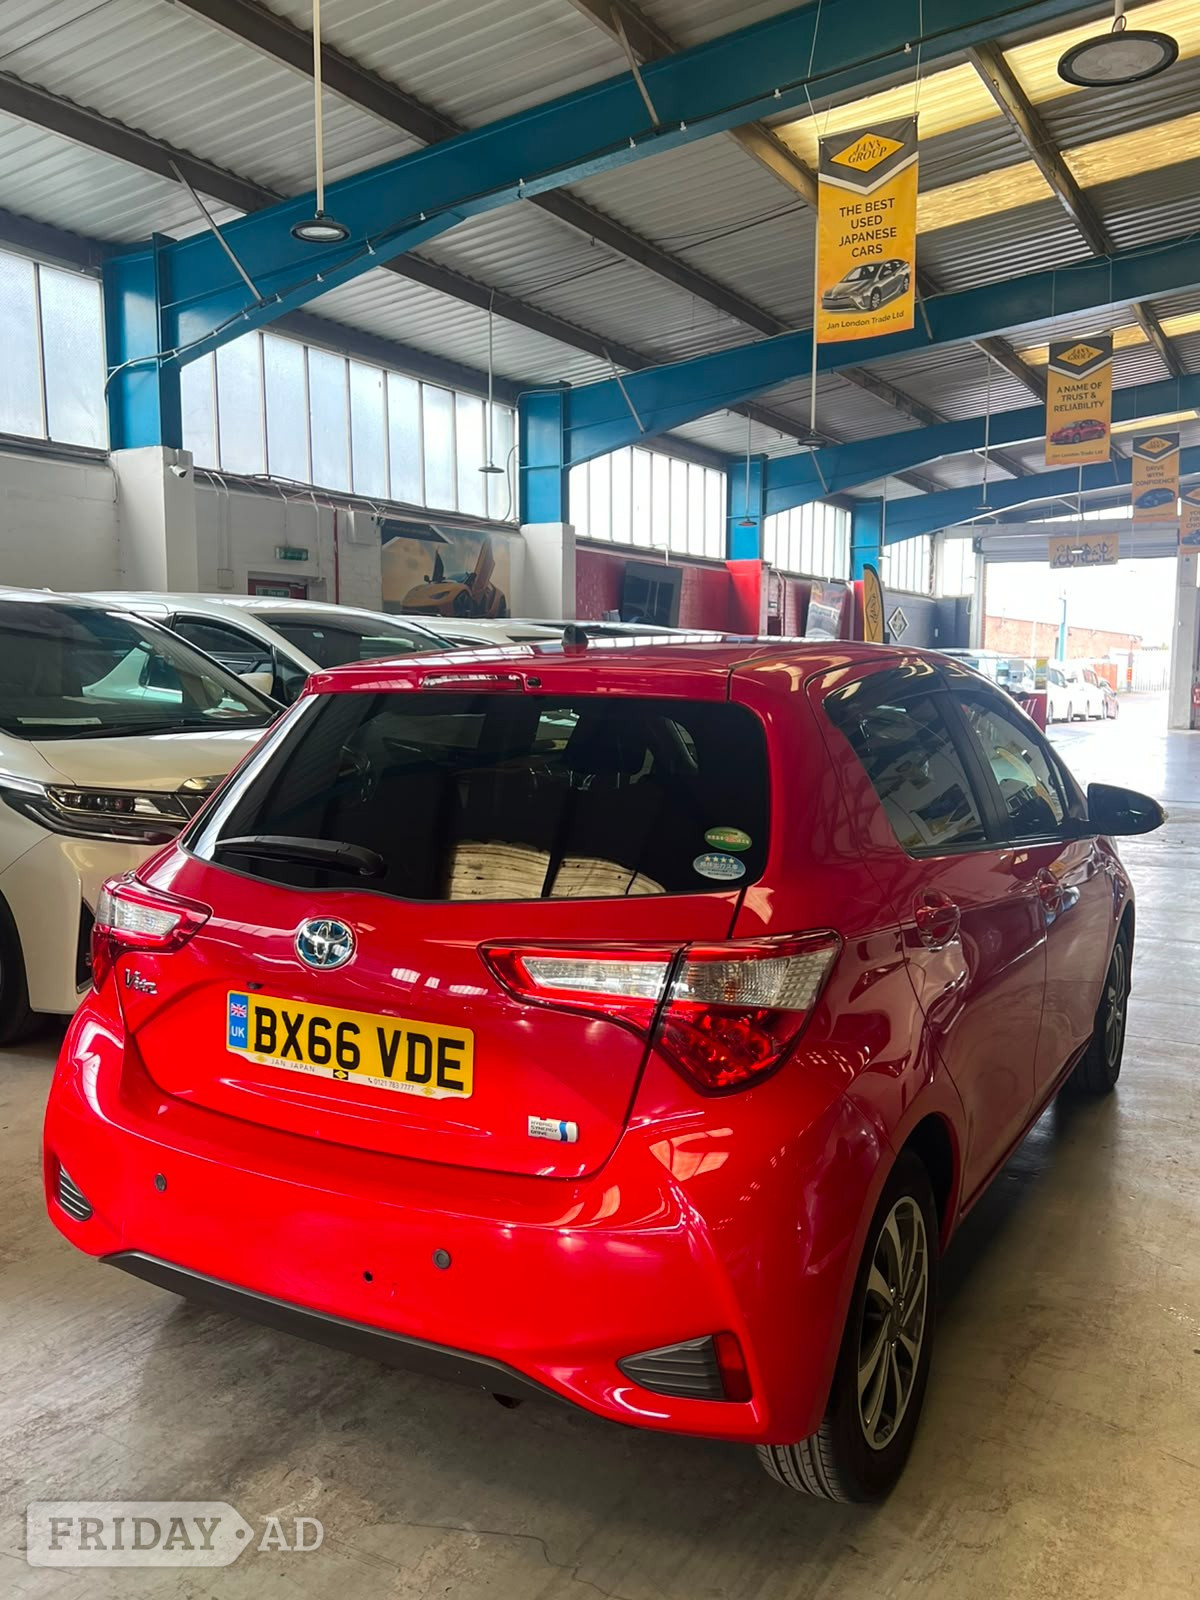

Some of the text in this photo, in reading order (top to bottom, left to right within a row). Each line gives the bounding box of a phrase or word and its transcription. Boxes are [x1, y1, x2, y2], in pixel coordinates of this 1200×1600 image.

[848, 146, 887, 163] GROUP
[839, 197, 896, 217] THE BEST
[850, 215, 883, 229] USED
[838, 227, 897, 247] JAPANESE
[851, 243, 883, 258] CARS
[826, 310, 905, 330] Jan London Trade Ltd
[1056, 381, 1103, 394] A NAME OF
[1061, 391, 1097, 402] TRUST &
[1053, 400, 1105, 412] RELIABILITY
[1136, 477, 1175, 486] CONFIDENCE
[230, 1026, 245, 1038] UK
[254, 1006, 466, 1091] BX66 VDE
[271, 1058, 315, 1072] JAN JAPAN
[373, 1078, 388, 1087] 0121
[400, 1082, 414, 1091] 7777
